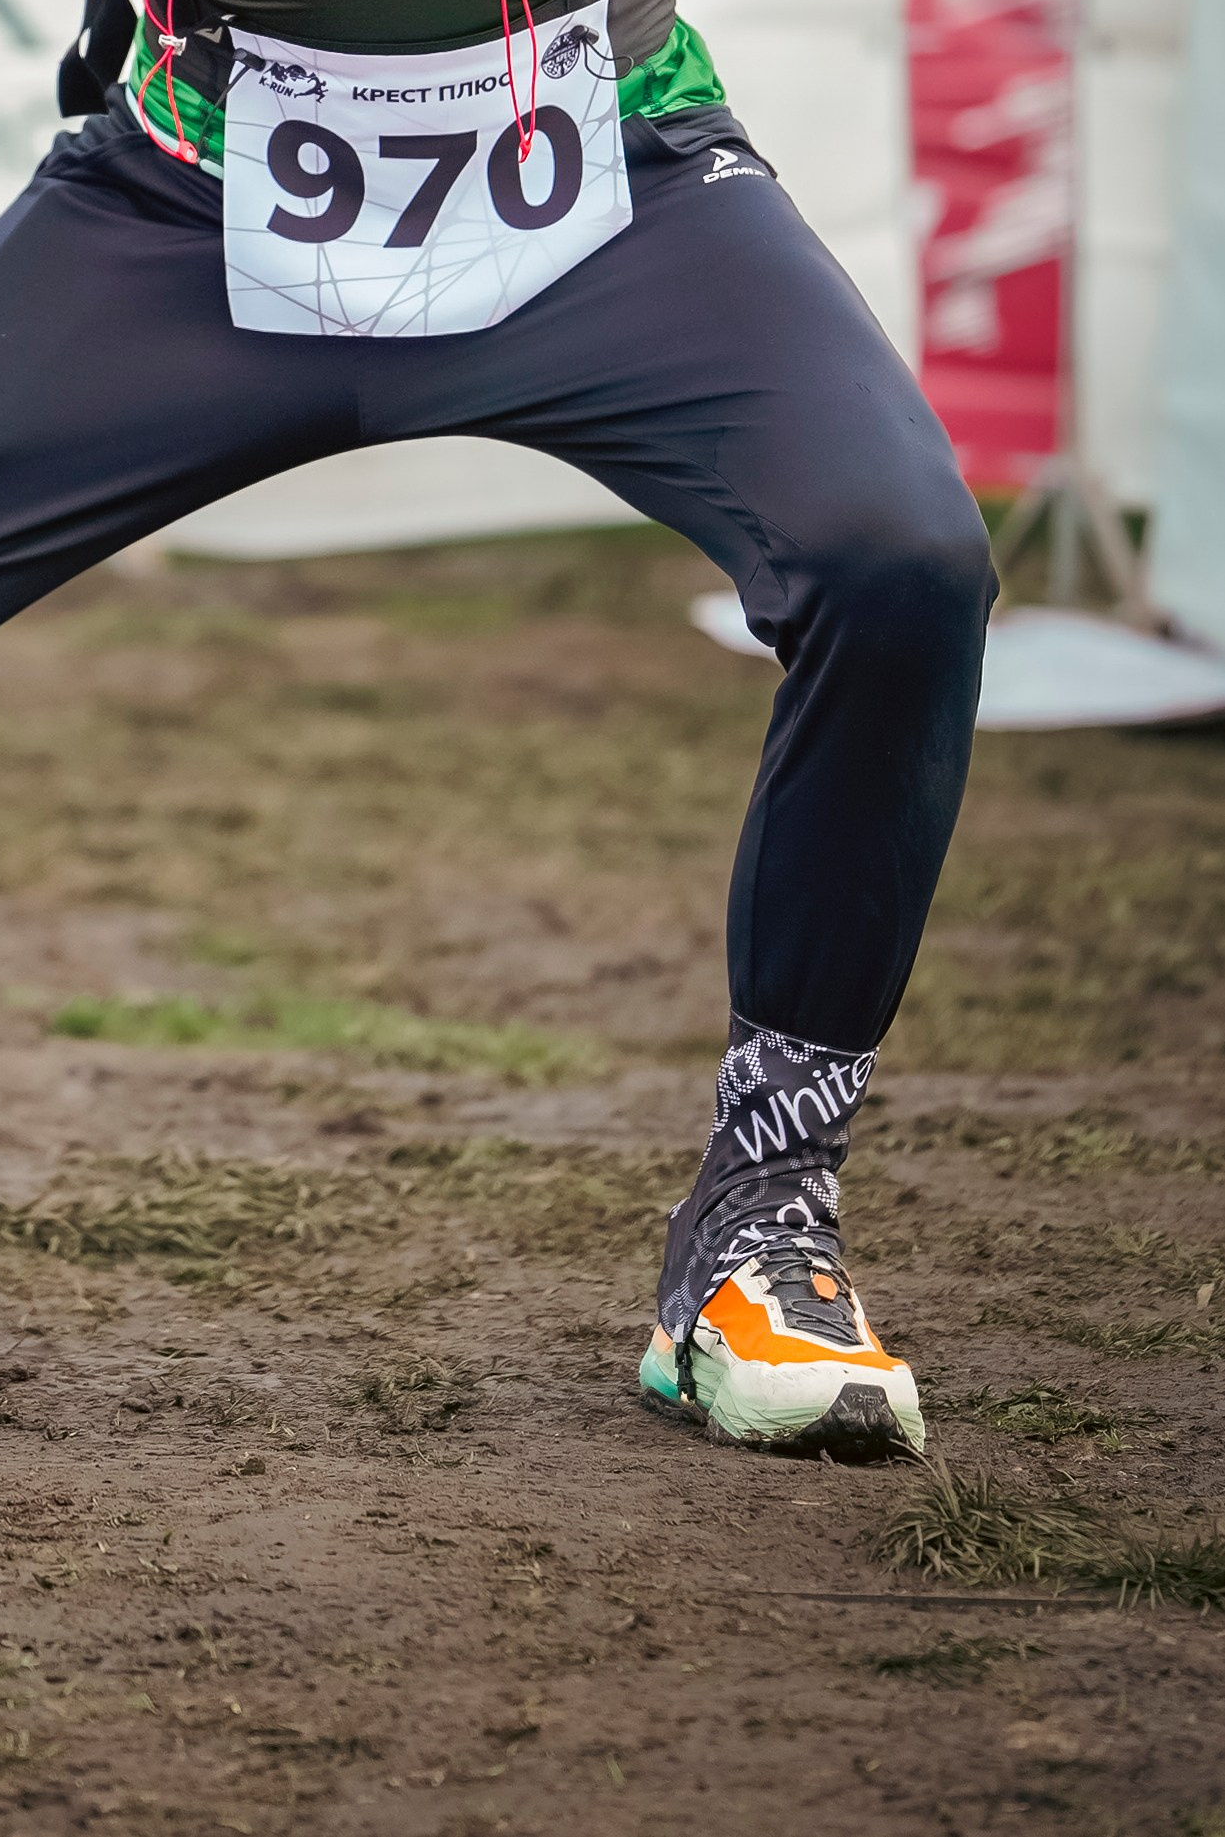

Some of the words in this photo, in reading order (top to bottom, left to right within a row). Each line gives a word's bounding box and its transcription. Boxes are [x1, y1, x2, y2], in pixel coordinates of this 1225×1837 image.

[258, 75, 294, 98] K-RUN
[352, 85, 432, 104] КРЕСТ
[439, 72, 512, 102] ПЛЮС
[266, 104, 583, 249] 970
